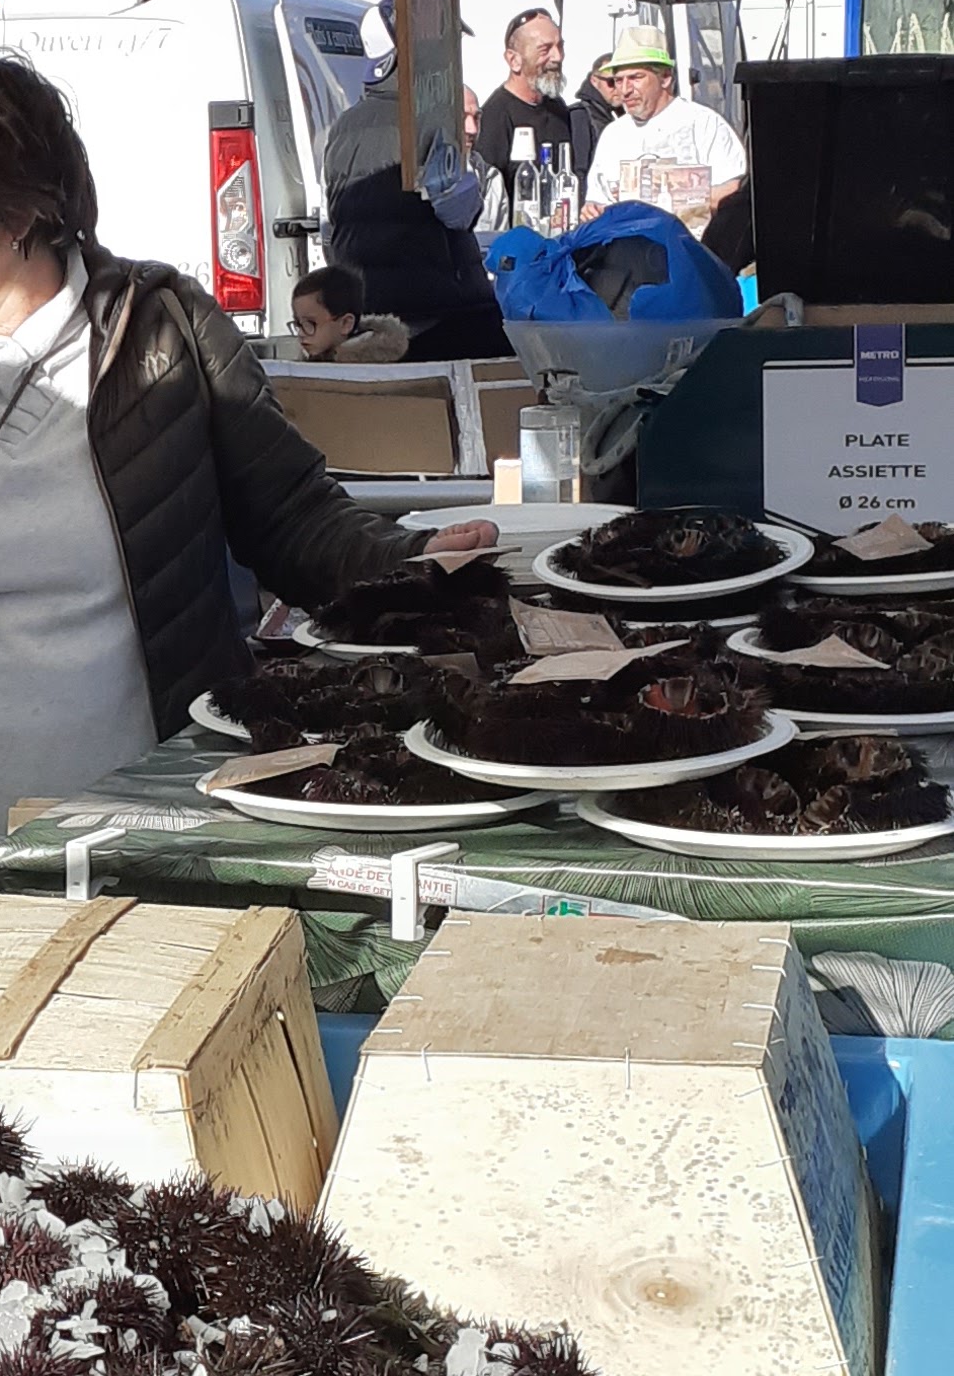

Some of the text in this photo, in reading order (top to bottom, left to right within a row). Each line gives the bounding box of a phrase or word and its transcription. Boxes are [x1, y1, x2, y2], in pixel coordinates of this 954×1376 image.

[860, 350, 900, 360] METRO
[845, 434, 910, 447] PLATE
[828, 465, 926, 478] ASSIETTE
[858, 496, 880, 509] 26
[886, 498, 915, 509] cm
[327, 865, 363, 878] ANDE
[367, 870, 384, 882] DE
[337, 881, 356, 891] CAS
[358, 884, 371, 893] DE
